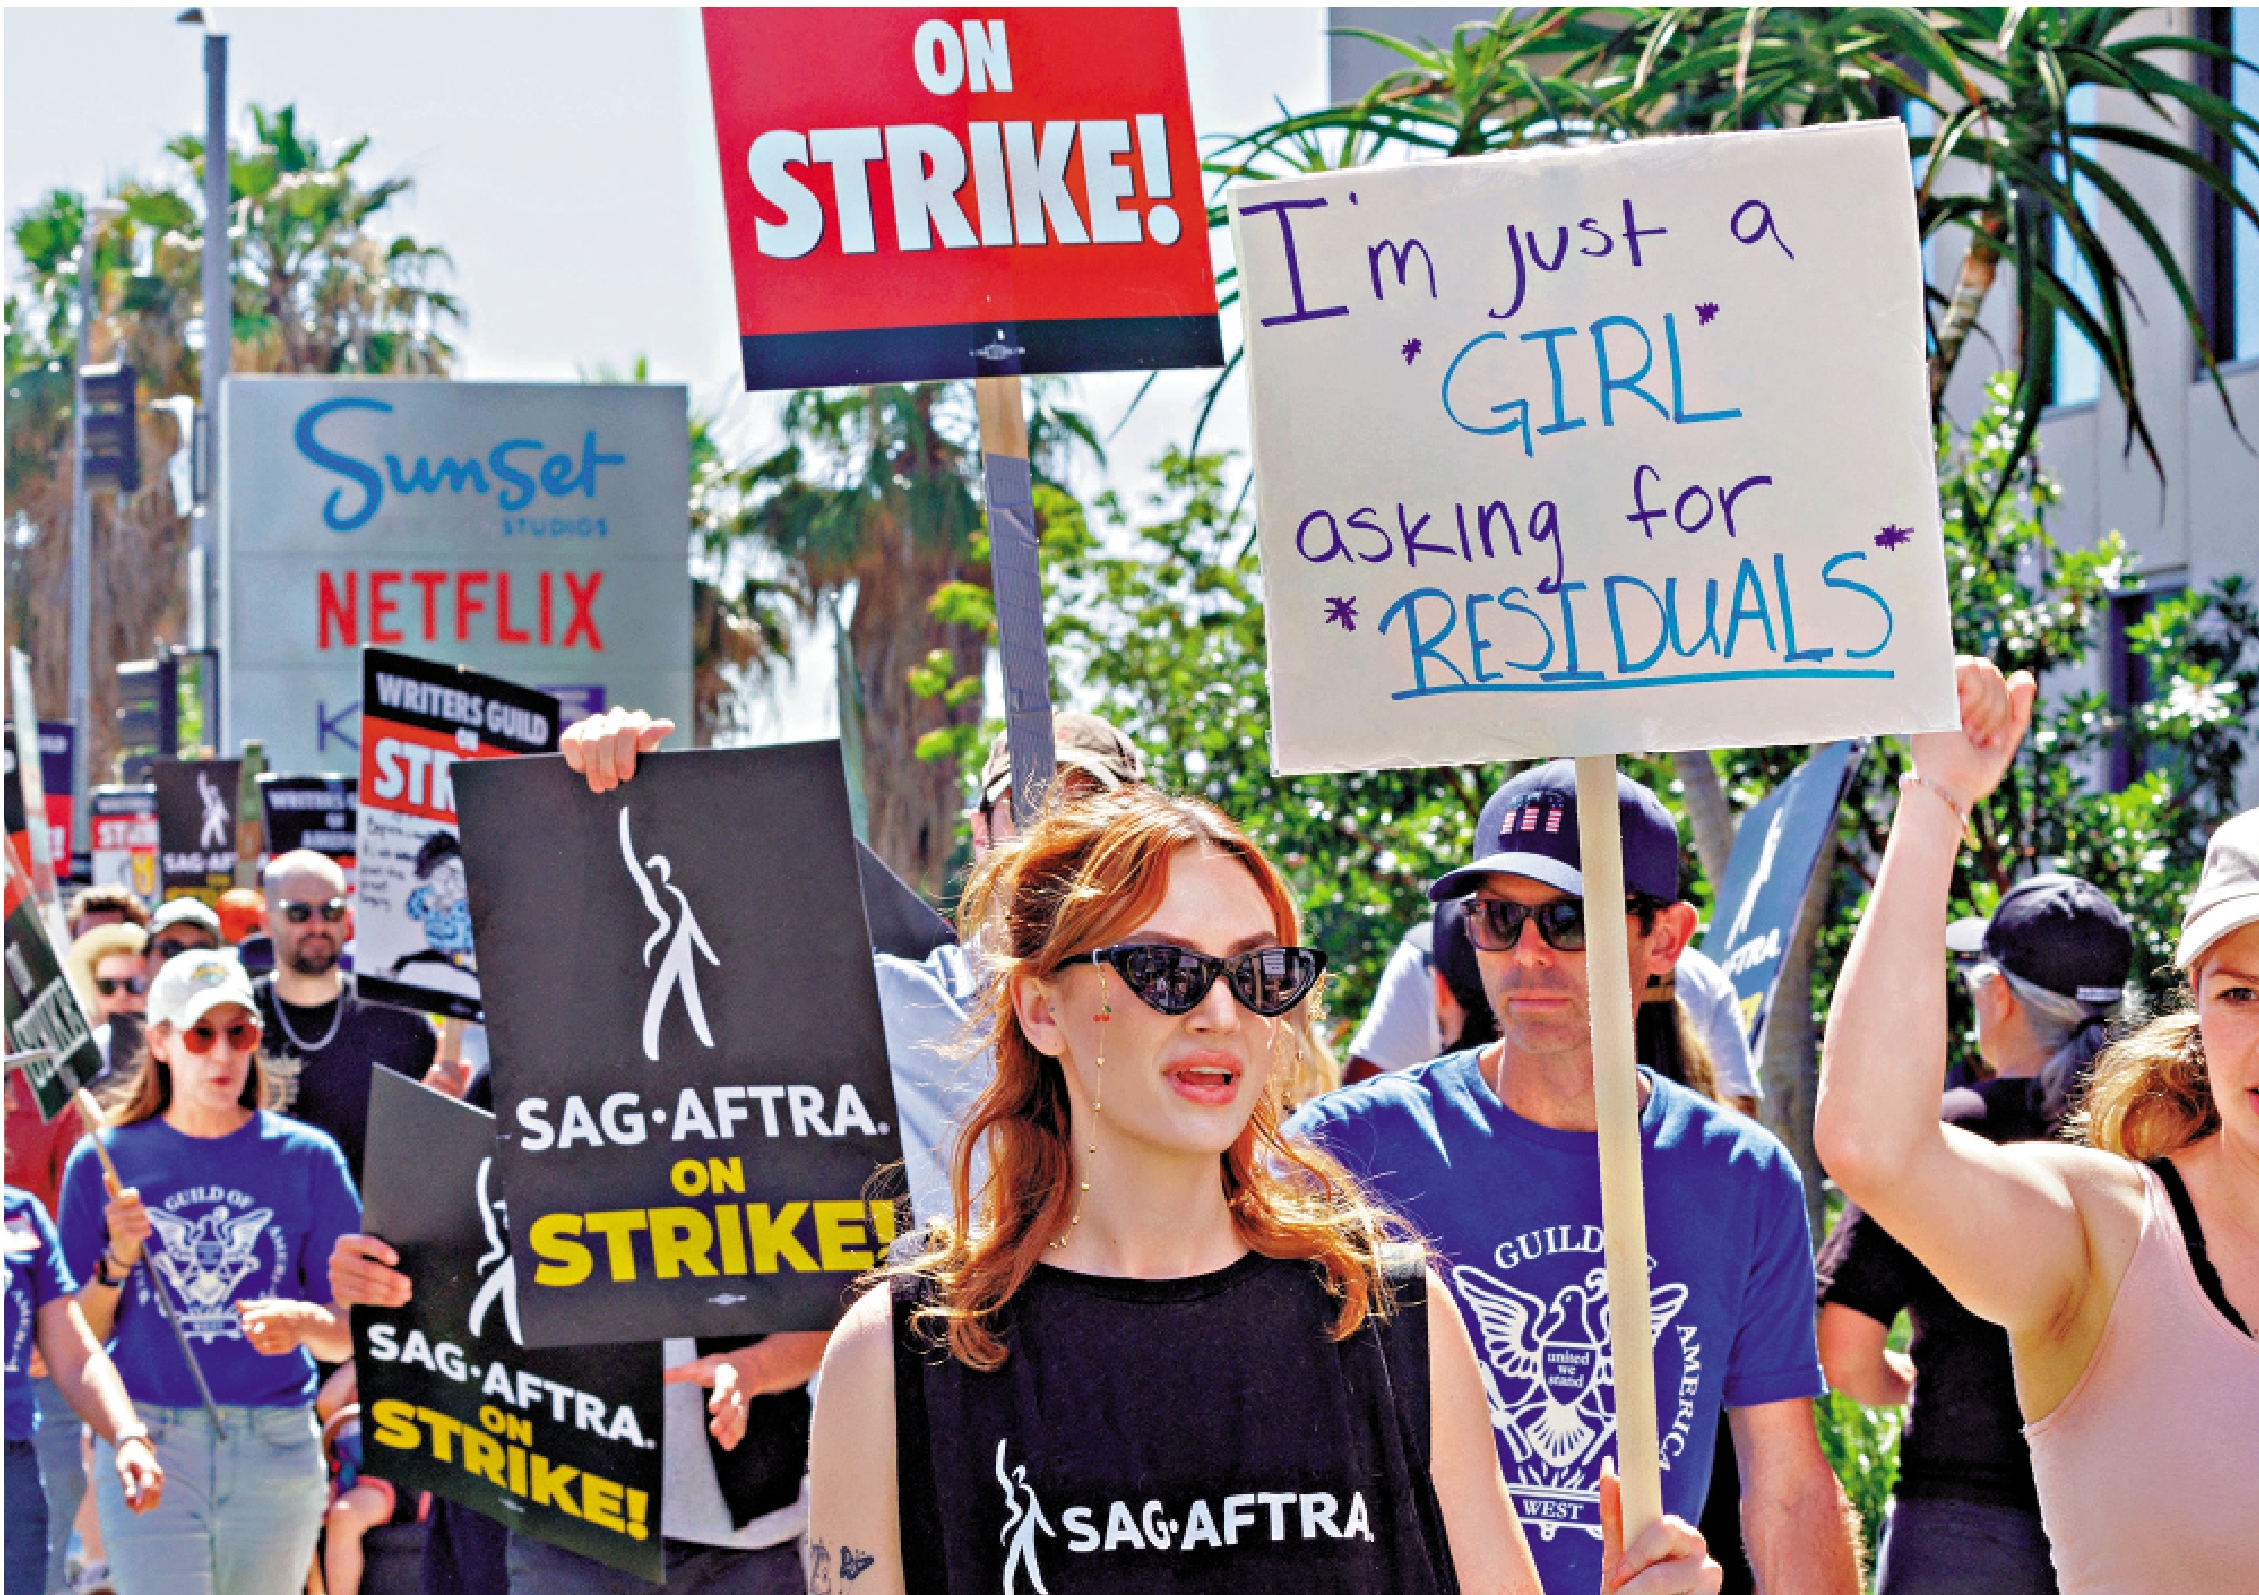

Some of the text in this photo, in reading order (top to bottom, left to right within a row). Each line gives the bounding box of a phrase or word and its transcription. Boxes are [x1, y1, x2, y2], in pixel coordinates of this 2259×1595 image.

[912, 18, 1013, 96] ON
[747, 113, 1182, 259] STRIKE!
[1239, 190, 1794, 327] I'm just a
[503, 516, 608, 537] STUDIOS
[1295, 464, 1773, 595] asking for
[317, 569, 605, 651] NETFLIX
[375, 671, 483, 729] WRITERS
[485, 699, 551, 746] GUILD
[670, 1156, 747, 1197] ON
[528, 1198, 897, 1287] STRIKE!
[1493, 1223, 1606, 1269] GUILD
[1547, 1349, 1591, 1365] united
[1547, 1373, 1586, 1388] stand
[1556, 1364, 1578, 1375] we
[478, 1404, 533, 1448] ON
[371, 1397, 650, 1542] STRIKE!
[1521, 1498, 1586, 1520] WEST
